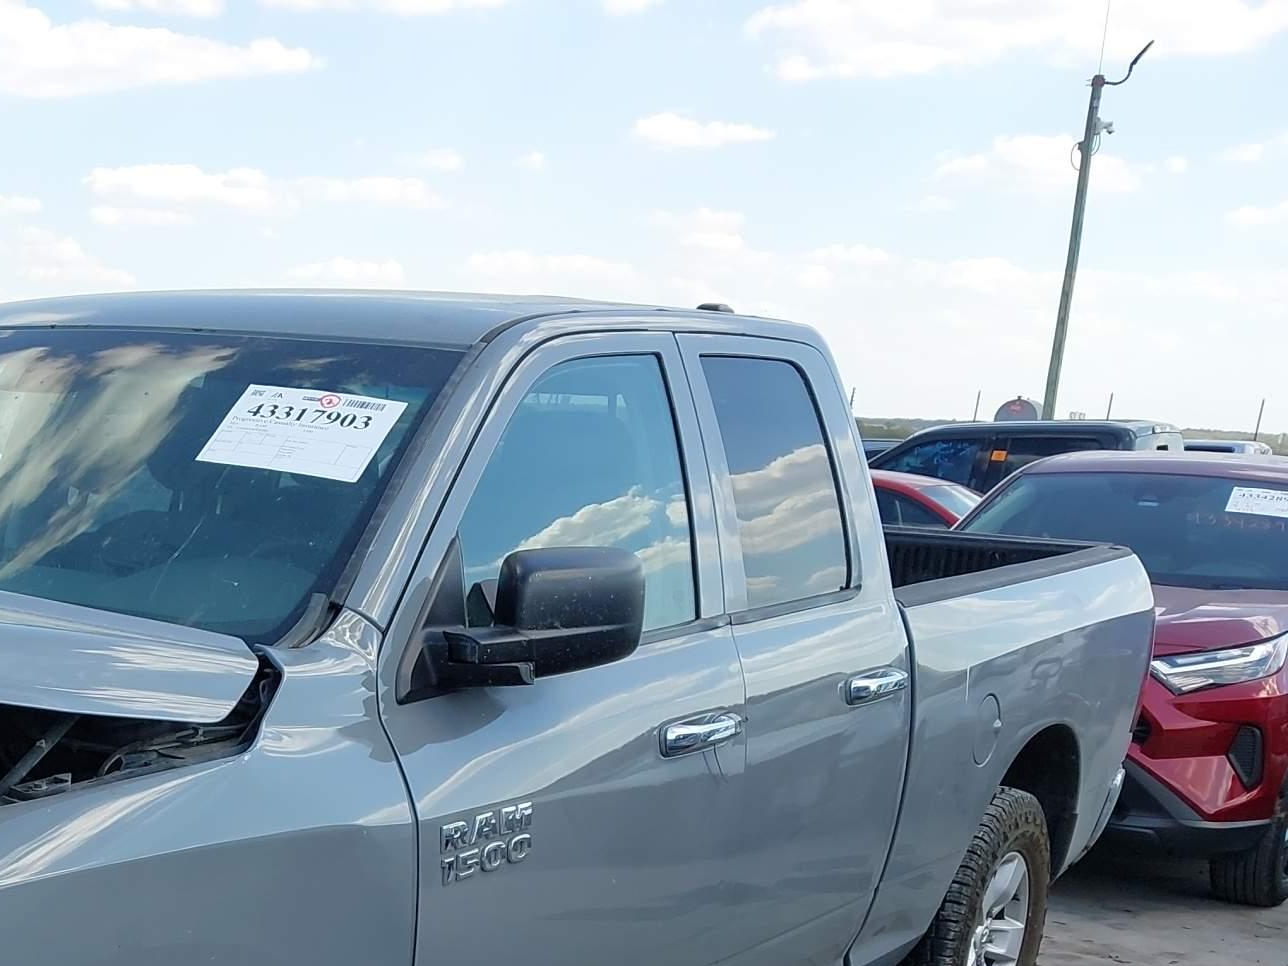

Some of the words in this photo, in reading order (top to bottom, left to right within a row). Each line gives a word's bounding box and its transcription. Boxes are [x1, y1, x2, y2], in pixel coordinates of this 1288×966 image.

[247, 403, 373, 430] 43317903
[440, 801, 533, 854] RAM
[441, 833, 532, 887] 1500
